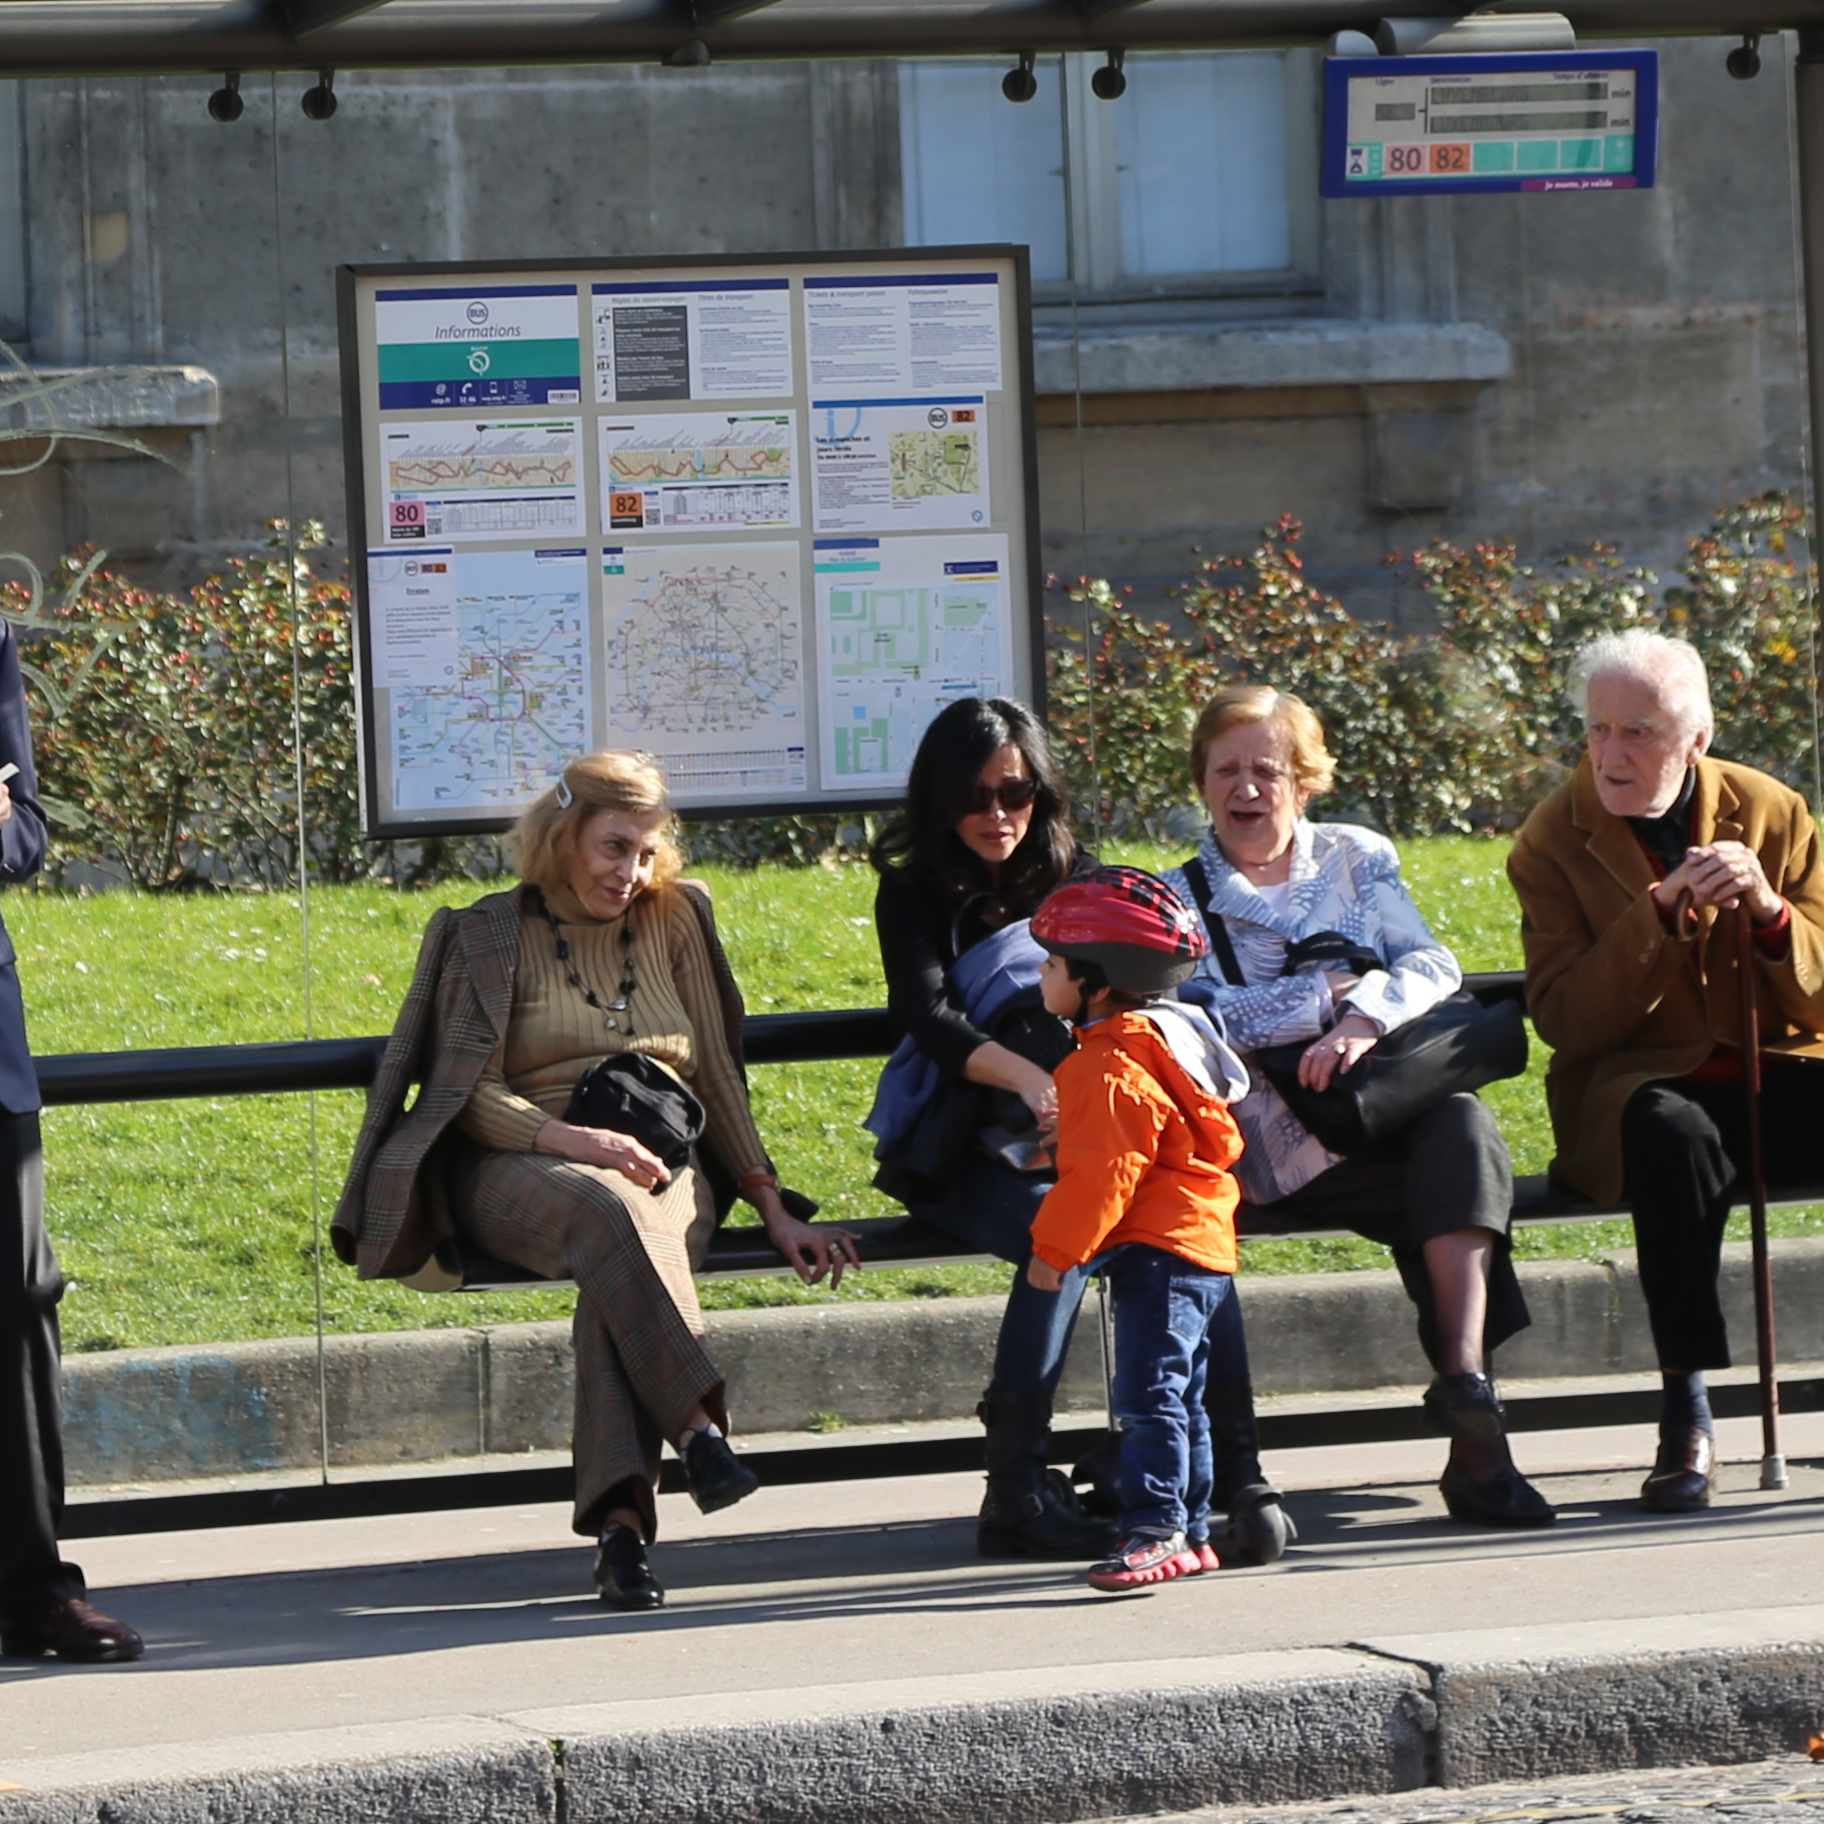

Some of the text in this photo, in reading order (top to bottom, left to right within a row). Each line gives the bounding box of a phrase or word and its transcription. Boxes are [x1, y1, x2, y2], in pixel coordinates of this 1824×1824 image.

[1611, 89, 1632, 99] min
[1611, 117, 1631, 127] min
[1389, 149, 1422, 170] 80
[1436, 147, 1464, 169] 82
[469, 309, 486, 318] BUS
[435, 325, 521, 340] Informations
[956, 410, 970, 421] 82
[615, 496, 638, 513] 82
[395, 505, 419, 522] 80
